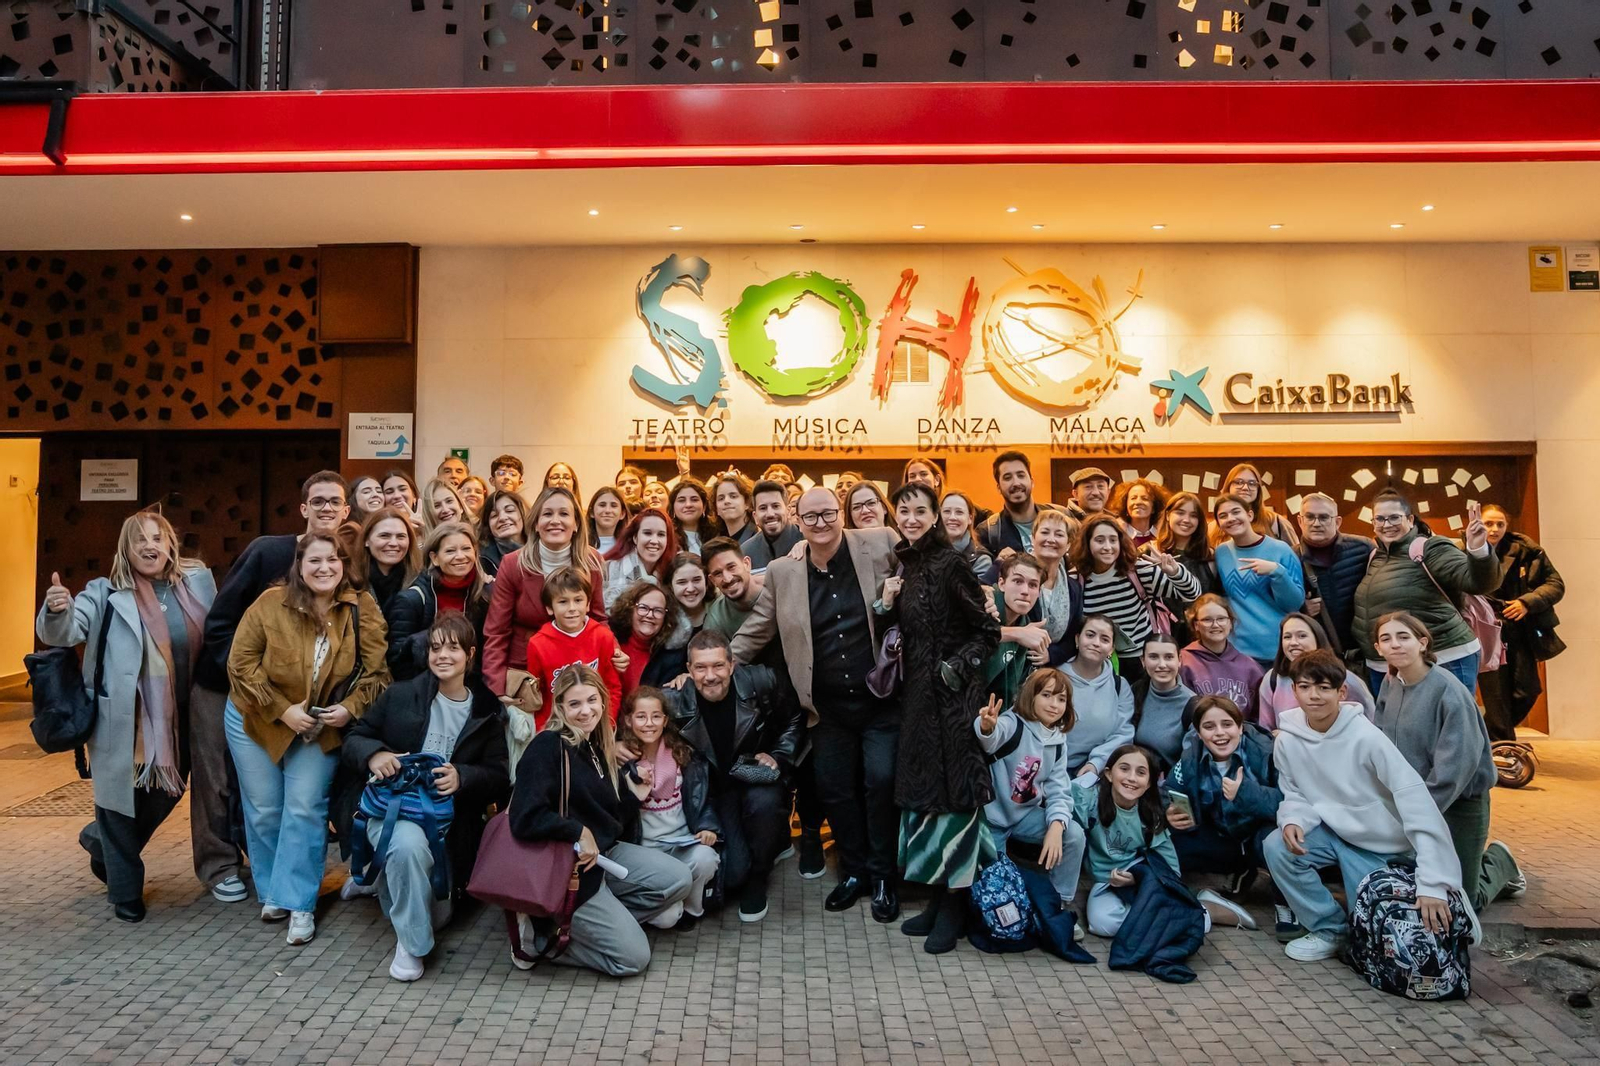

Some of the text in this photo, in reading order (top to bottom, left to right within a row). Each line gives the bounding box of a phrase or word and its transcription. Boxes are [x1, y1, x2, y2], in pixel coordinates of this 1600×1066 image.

[632, 253, 1143, 409] SOHO
[1226, 372, 1415, 406] CaixaBank
[632, 414, 1146, 435] TEATRO MÚSICA DANZA MÁLAGA
